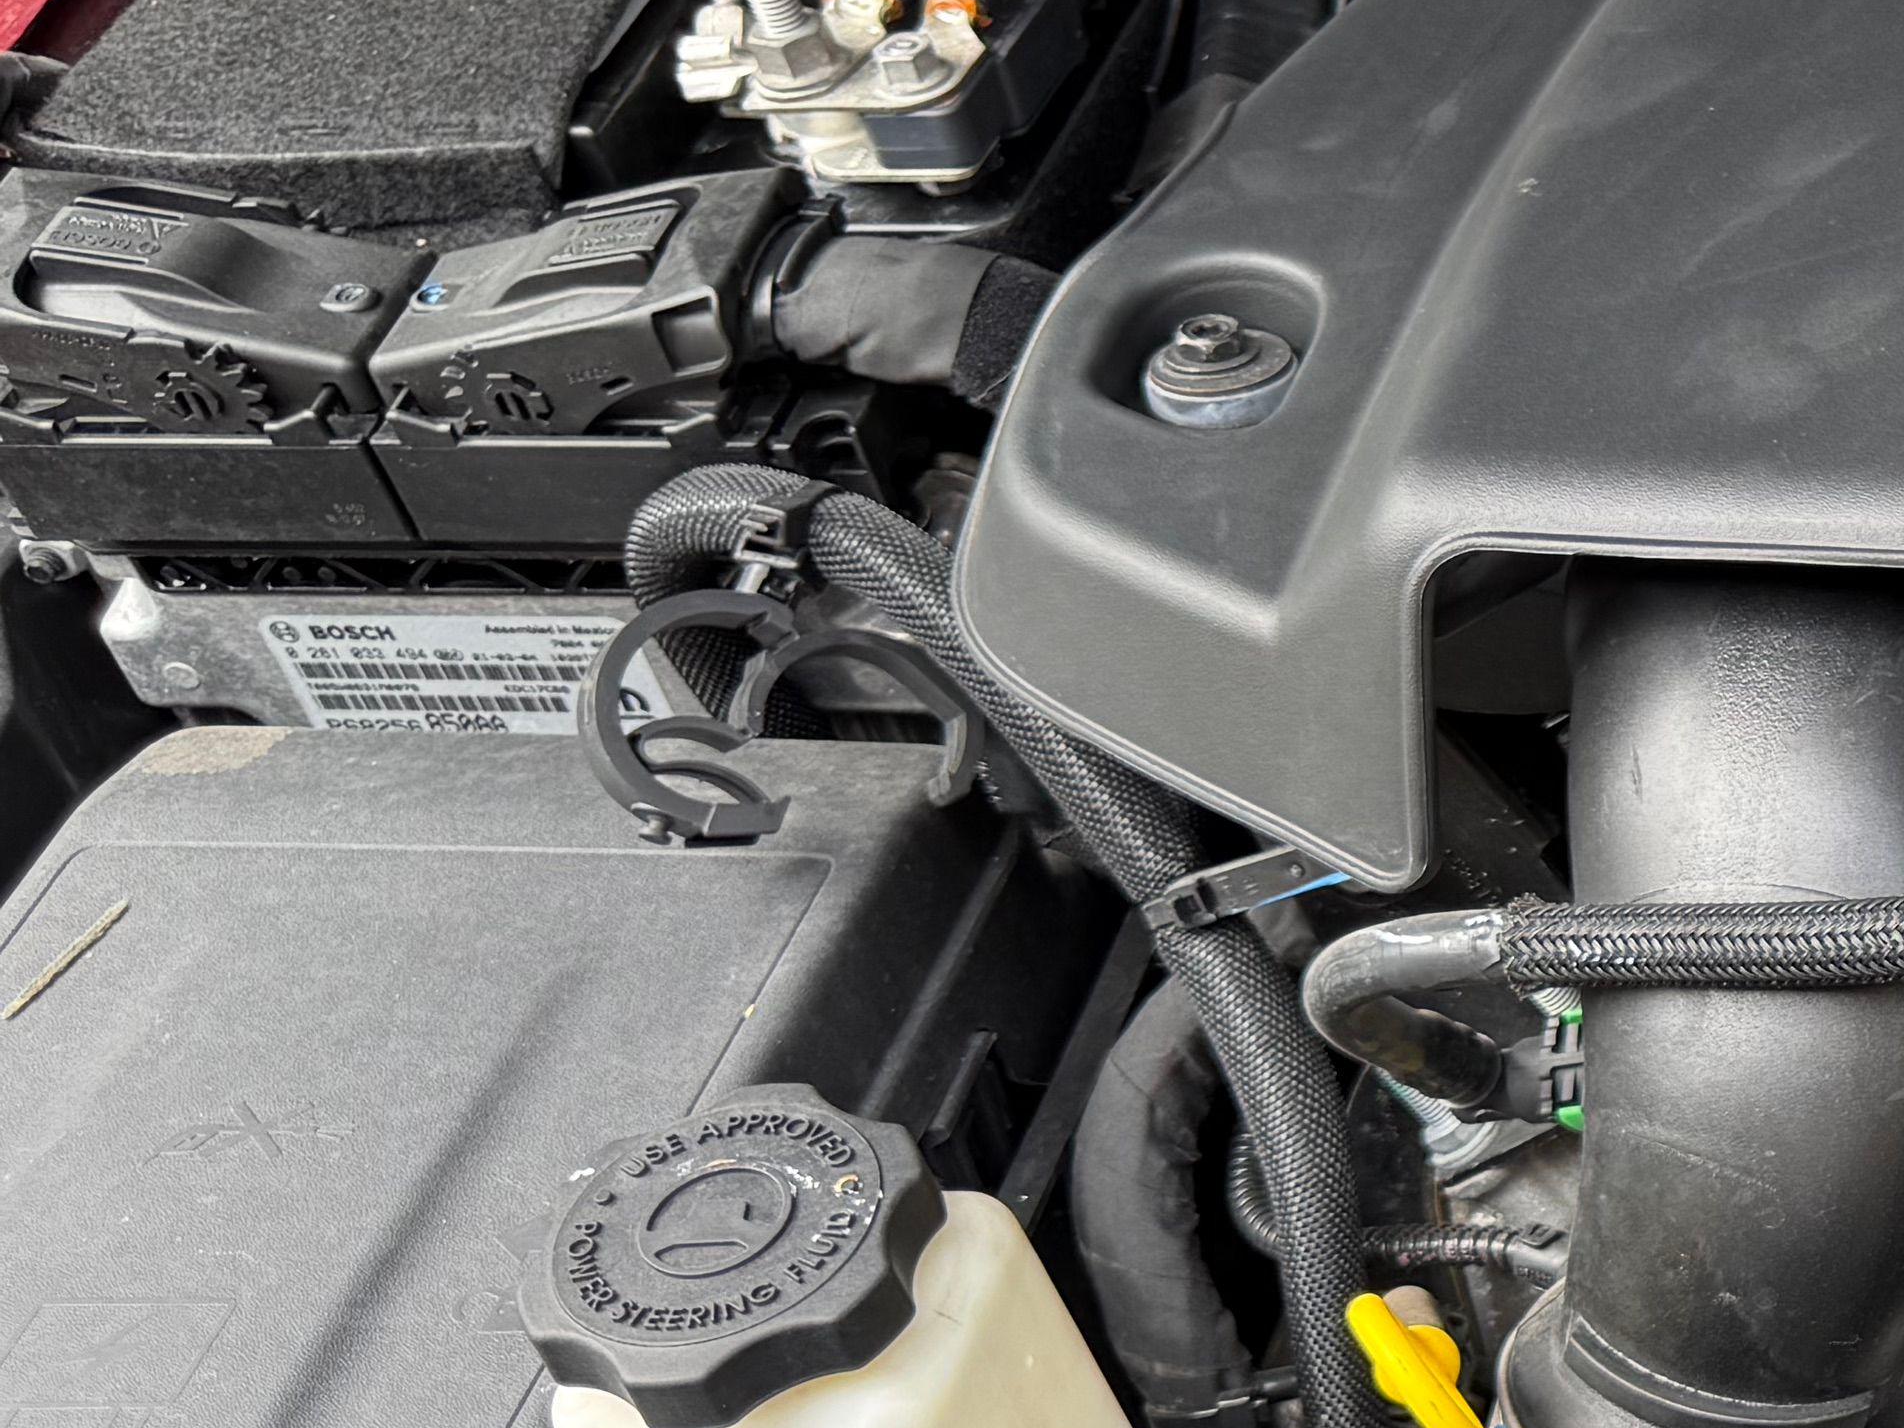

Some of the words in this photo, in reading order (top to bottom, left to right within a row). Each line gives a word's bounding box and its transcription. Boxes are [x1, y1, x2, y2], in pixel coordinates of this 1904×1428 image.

[308, 624, 397, 641] BOSCH
[620, 1134, 687, 1179] USE
[697, 1113, 855, 1168] APPROVED
[568, 1219, 620, 1313] POWER
[611, 1281, 780, 1332] STEERING
[783, 1210, 857, 1284] FLUID
